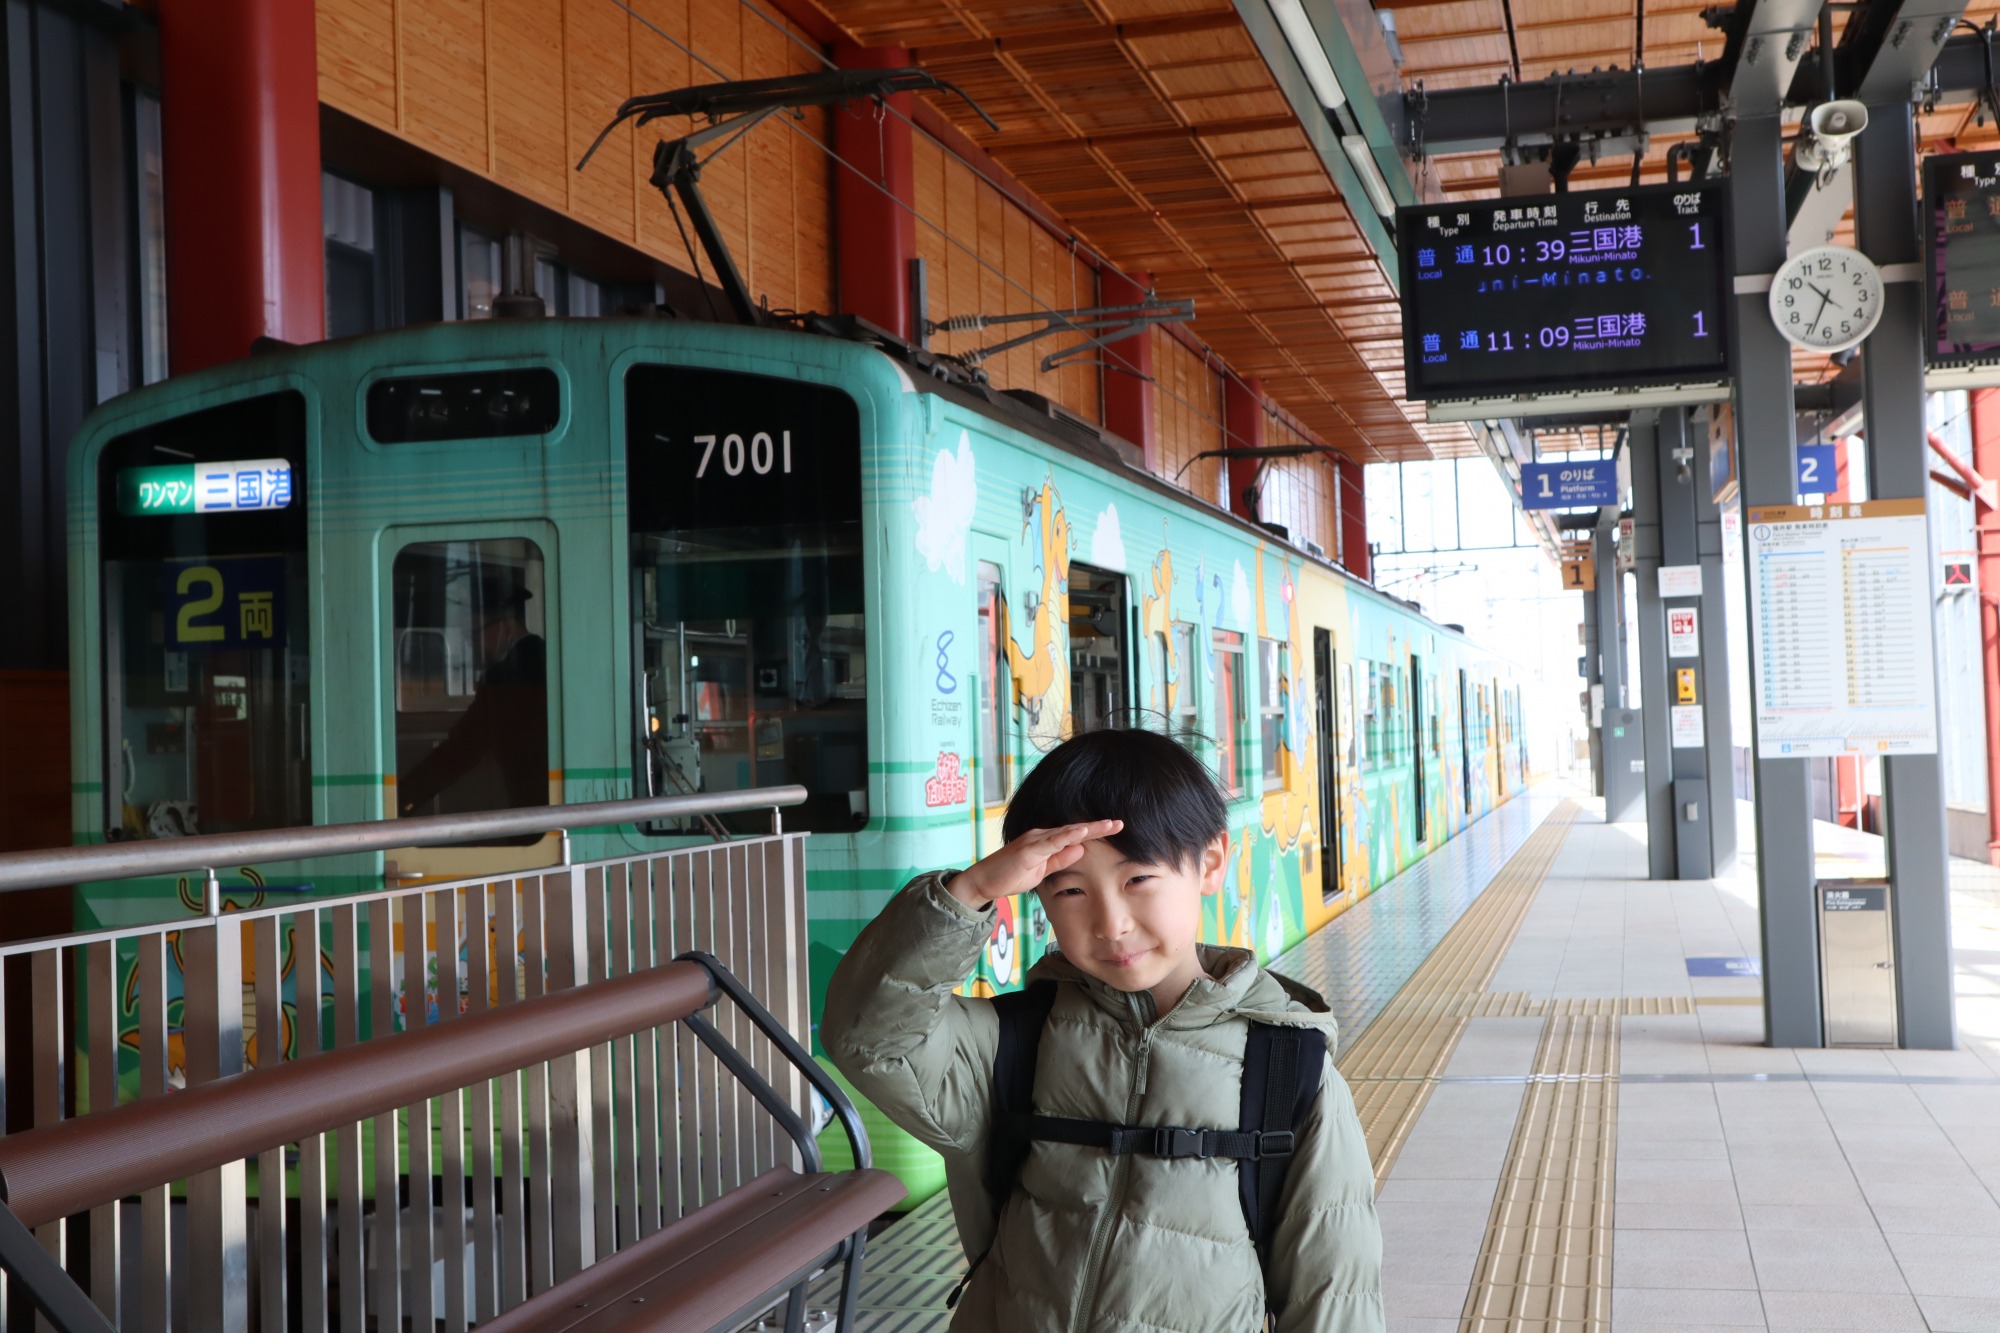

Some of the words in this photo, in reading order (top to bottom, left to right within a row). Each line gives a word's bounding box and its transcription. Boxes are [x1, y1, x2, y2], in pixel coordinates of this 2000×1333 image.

[1974, 176, 1997, 188] Type
[1673, 192, 1701, 206] のりば
[1493, 205, 1557, 221] 発車時刻
[1585, 199, 1630, 214] 行先
[1677, 205, 1699, 215] Track
[1584, 211, 1631, 223] Destination
[1493, 220, 1535, 232] Departure
[1537, 218, 1558, 227] Time
[1945, 223, 1974, 233] Local
[1440, 227, 1459, 237] Type
[1418, 245, 1475, 267] 普通
[1570, 225, 1643, 253] 三国港
[1689, 222, 1705, 249] 1
[1418, 269, 1443, 279] Local
[1569, 251, 1637, 264] Mikuni-Minato
[1802, 264, 1812, 276] 11
[1818, 258, 1832, 270] 12
[1841, 262, 1846, 273] 1
[1789, 277, 1802, 289] 10
[1853, 273, 1862, 285] 2
[1785, 295, 1794, 307] 9
[1858, 289, 1868, 302] 3
[1790, 311, 1800, 324] 8
[1853, 307, 1863, 319] 4
[1948, 312, 1975, 322] Local
[1422, 331, 1480, 352] 普通
[1573, 312, 1646, 340] 三国港
[1693, 311, 1708, 337] 1
[1804, 323, 1813, 335] 7
[1822, 326, 1832, 339] 6
[1841, 321, 1851, 333] 5
[1423, 353, 1447, 363] Local
[1573, 338, 1641, 351] Mikuni-Minato
[693, 430, 791, 478] 7001
[1560, 467, 1595, 482] のりば
[1801, 458, 1819, 483] 2
[139, 480, 193, 508] ワンマン
[204, 467, 291, 509] 三国港
[1537, 473, 1554, 498] 1
[1560, 484, 1595, 493] Platform
[1571, 566, 1584, 586] 1
[1672, 613, 1692, 621] STOP
[931, 698, 962, 711] Echizen
[931, 713, 962, 728] Railway
